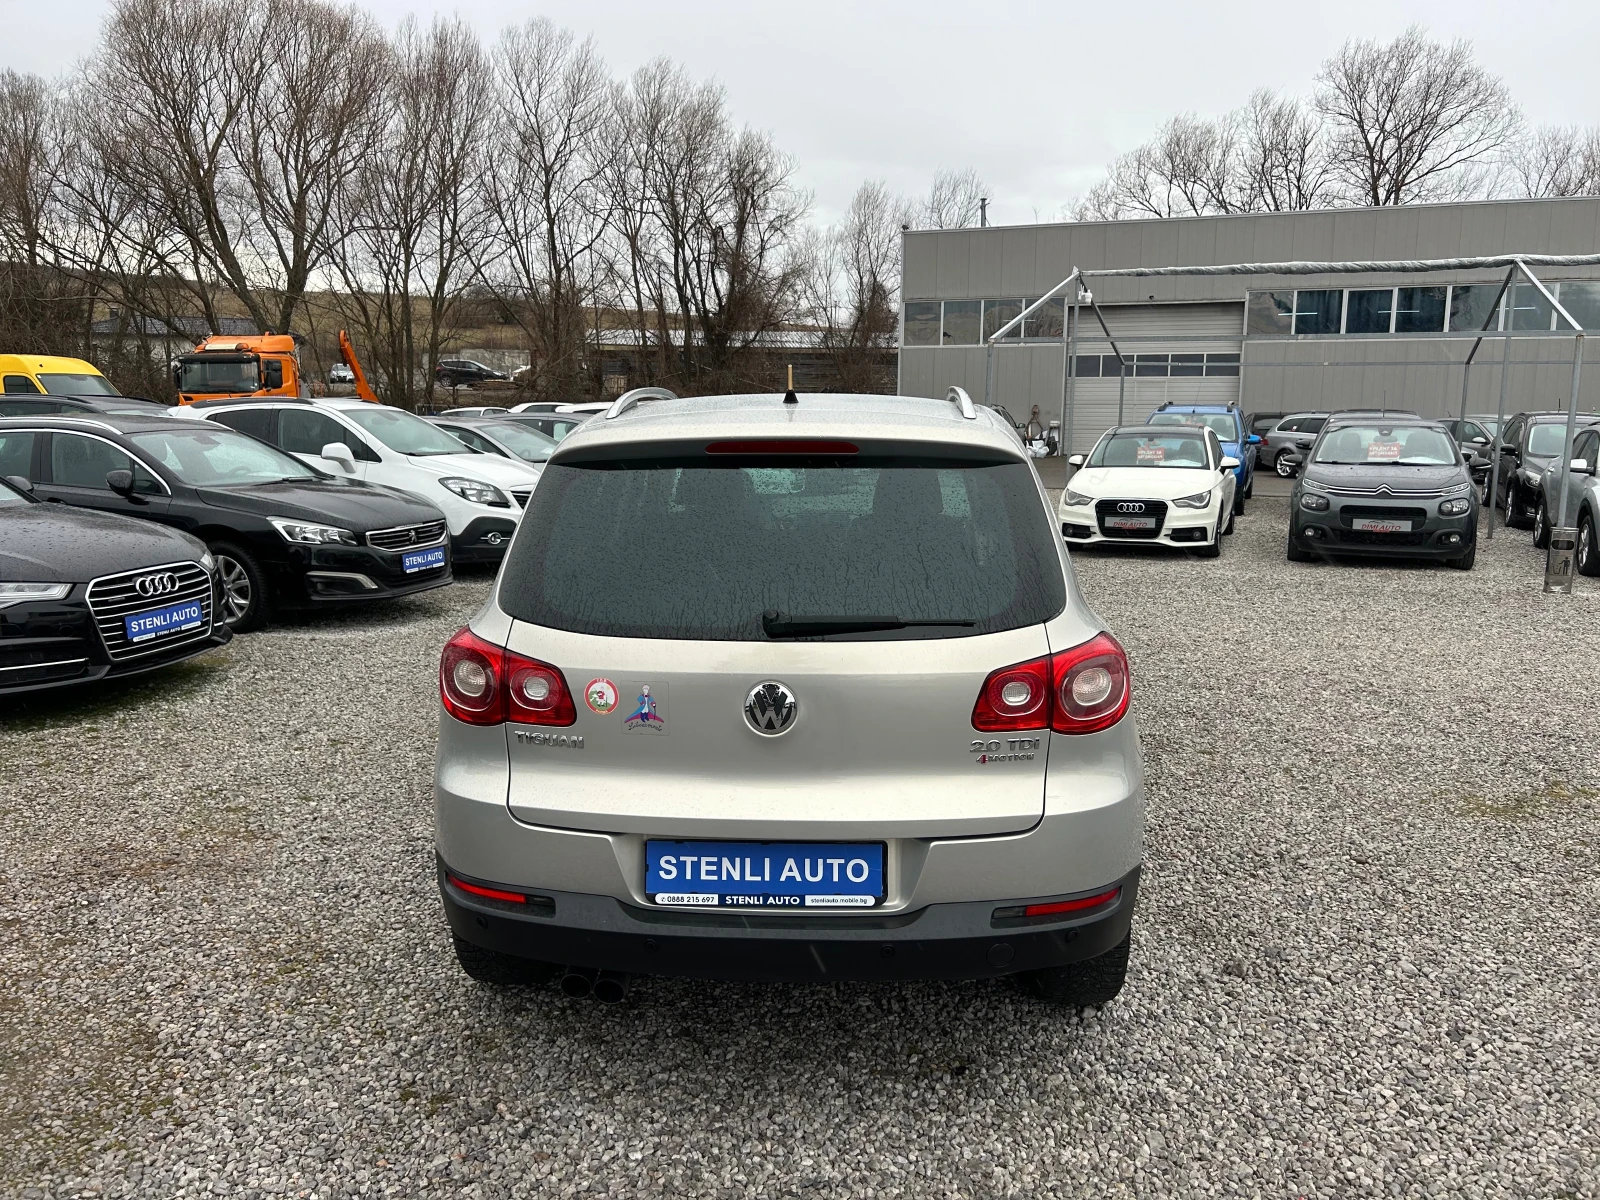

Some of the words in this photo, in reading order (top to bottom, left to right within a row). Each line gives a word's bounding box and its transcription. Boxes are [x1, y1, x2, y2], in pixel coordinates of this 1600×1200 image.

[405, 554, 427, 566] STENLI
[427, 551, 443, 562] AUTO
[131, 613, 170, 632] STENLI
[172, 606, 198, 623] AUTO
[514, 730, 585, 749] TIGUAN
[976, 752, 1035, 764] 4MOTION
[658, 855, 770, 882] STENLI
[779, 857, 870, 883] AUTO
[666, 895, 685, 903] 0888
[701, 896, 715, 904] 697
[725, 895, 763, 905] STENLI
[766, 896, 800, 905] AUTO
